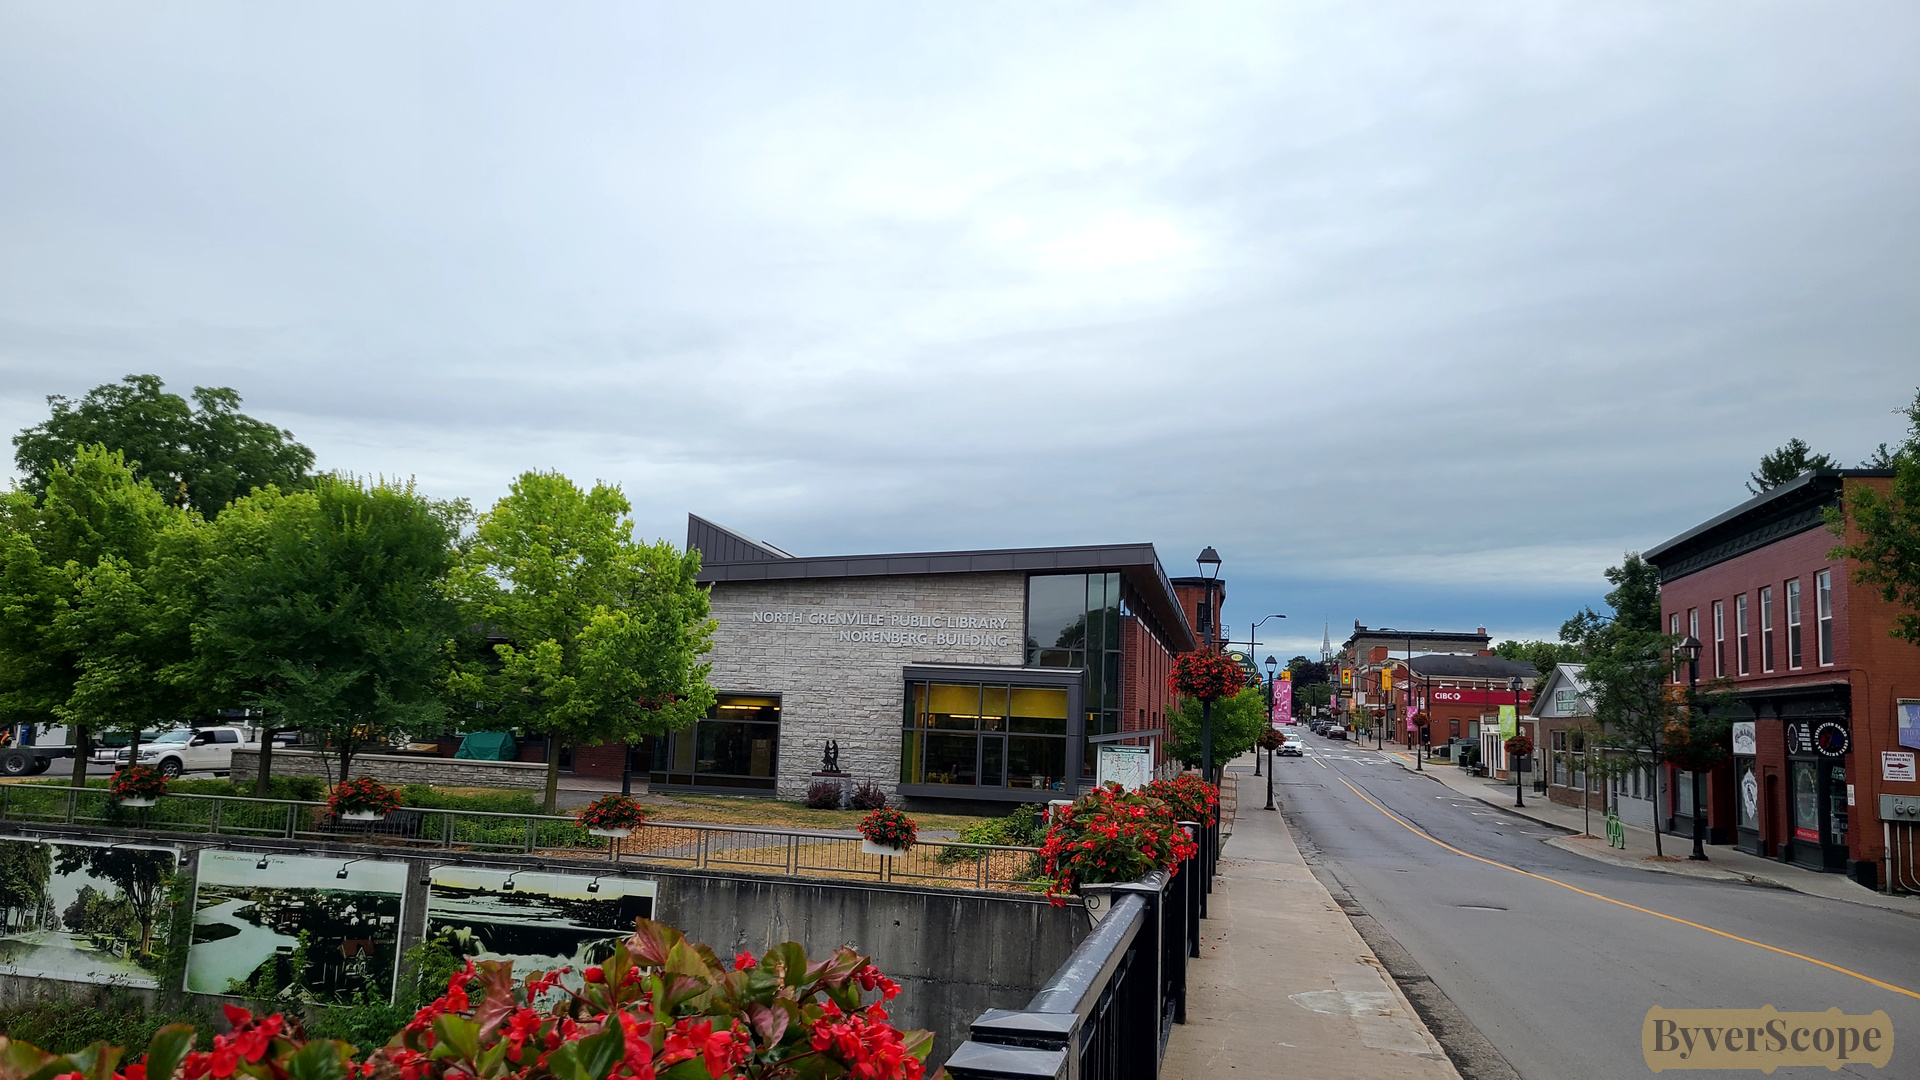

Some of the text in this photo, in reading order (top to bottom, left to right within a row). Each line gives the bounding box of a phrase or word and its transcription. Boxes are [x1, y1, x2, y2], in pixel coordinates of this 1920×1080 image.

[752, 611, 1007, 630] NORTH GRENVILLE PUBLIC LIBRARY
[839, 630, 1007, 647] NORENBERG BUILDING
[1434, 691, 1453, 701] CIBC
